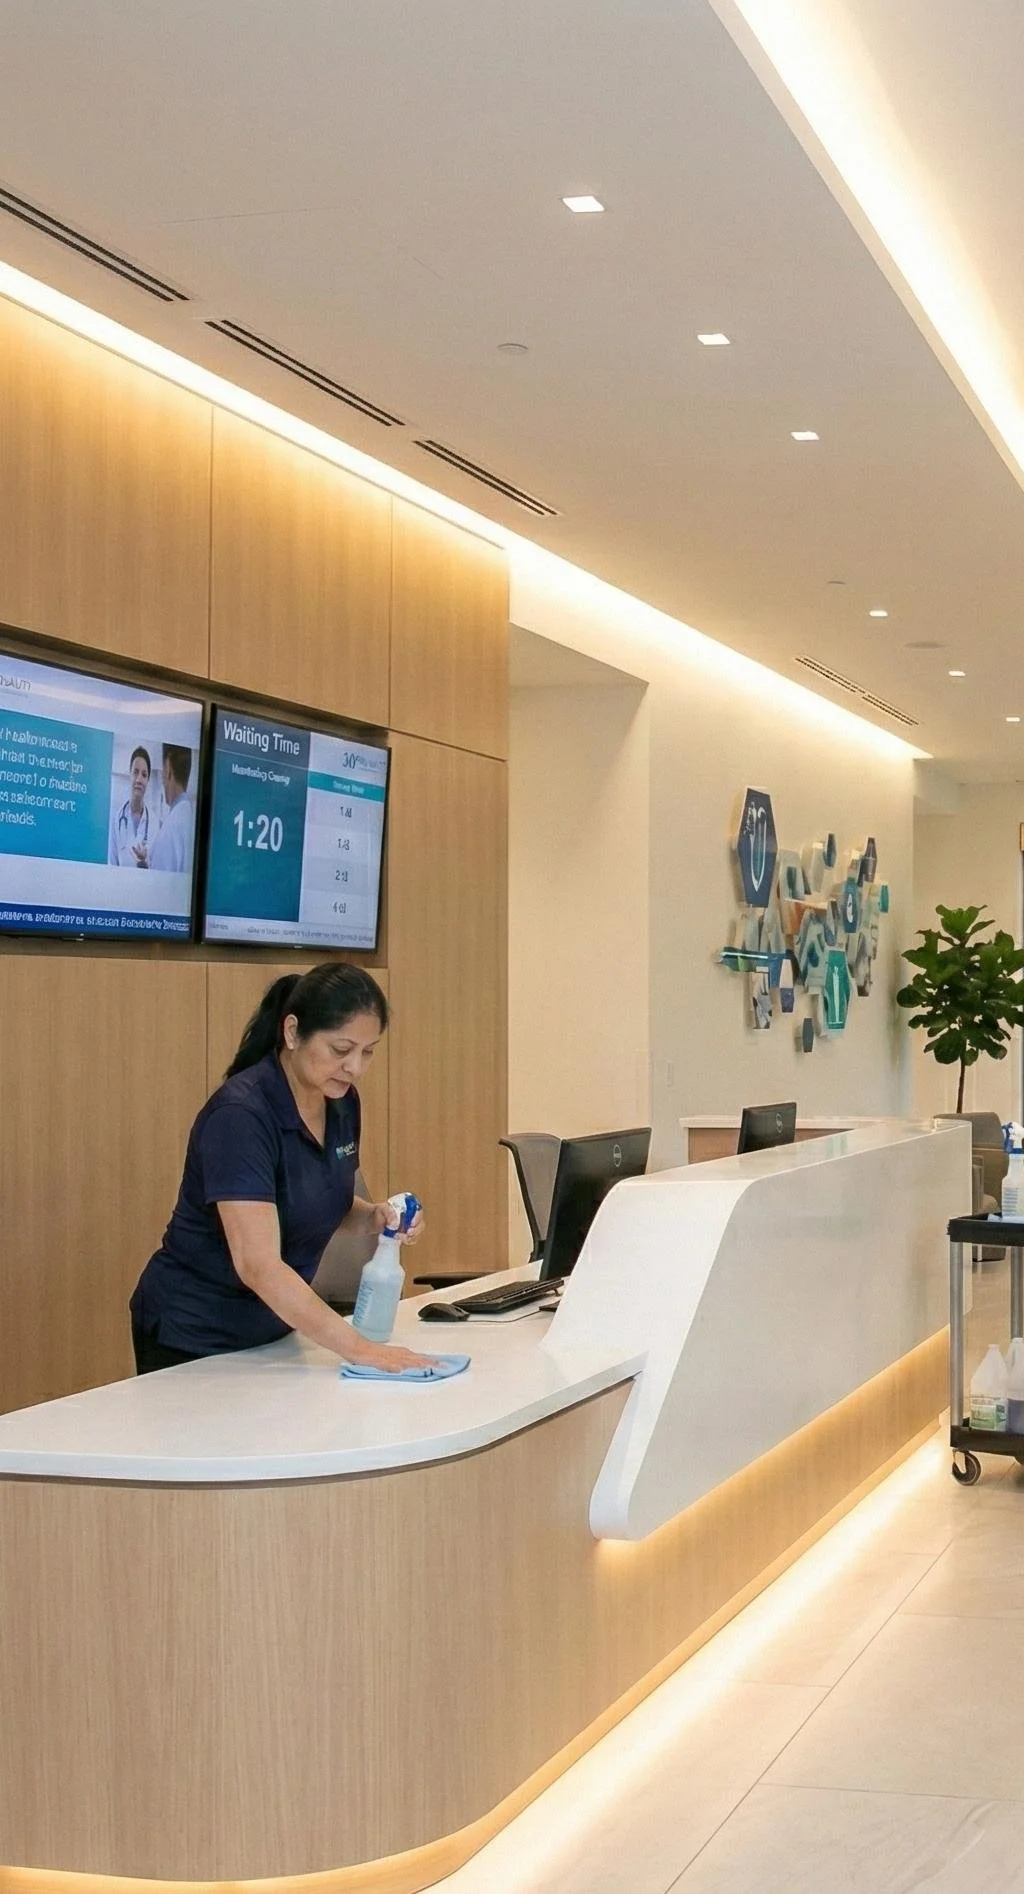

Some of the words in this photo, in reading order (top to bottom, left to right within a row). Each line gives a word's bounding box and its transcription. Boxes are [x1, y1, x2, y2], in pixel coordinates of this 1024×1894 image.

[224, 720, 269, 752] Waiting
[273, 733, 300, 755] Time
[234, 810, 283, 852] 1:20
